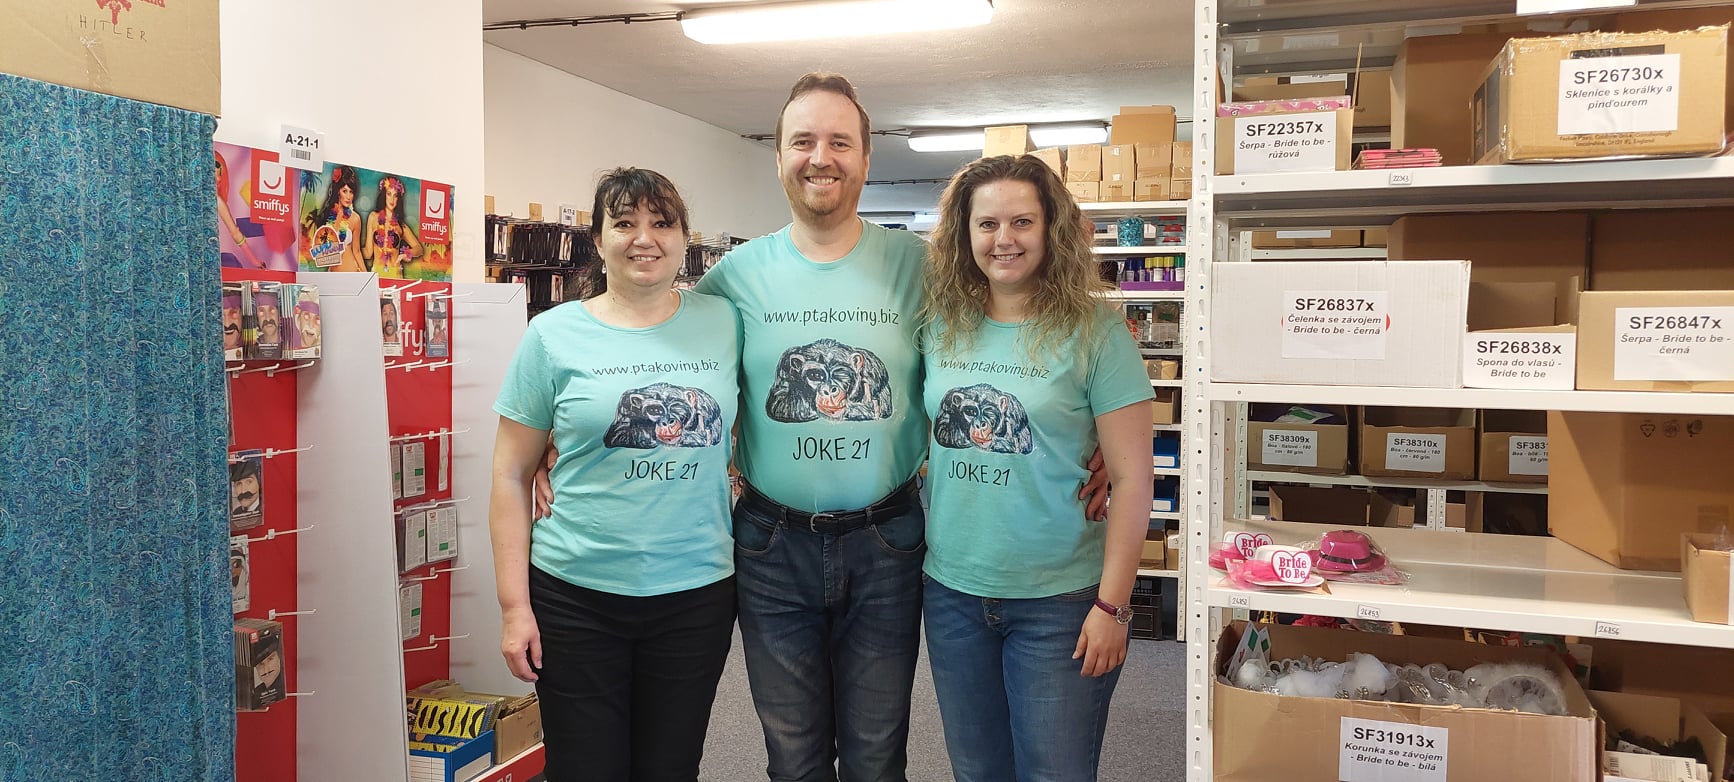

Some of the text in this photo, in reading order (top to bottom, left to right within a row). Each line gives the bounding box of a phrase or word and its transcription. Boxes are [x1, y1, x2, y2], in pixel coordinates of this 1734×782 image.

[80, 14, 147, 42] HITLER
[1574, 67, 1664, 84] SF26730x
[1565, 88, 1610, 99] Sklenice
[1622, 85, 1663, 95] korálky
[1246, 121, 1323, 136] SF22357x
[285, 133, 319, 149] A-21-1
[1239, 140, 1266, 150] Šerpa
[1274, 139, 1299, 148] Bride
[1313, 138, 1325, 146] be
[254, 198, 290, 216] smiffys
[421, 221, 447, 235] smiffys
[1295, 298, 1375, 311] SF26837x
[764, 306, 900, 326] www.ptakoviny.biz
[1287, 314, 1325, 323] Čelenka
[1341, 316, 1382, 325] závojem
[1629, 316, 1722, 329] SF26847x
[1293, 325, 1319, 333] Bride
[1321, 326, 1330, 334] to
[1333, 326, 1345, 334] be
[1353, 327, 1381, 335] černá
[1620, 333, 1652, 344] Šerpa
[1662, 334, 1692, 343] Bride
[1695, 335, 1706, 343] to
[1709, 334, 1724, 343] be
[1476, 340, 1562, 354] SF26838x
[1659, 345, 1690, 354] černá
[592, 359, 720, 376] www.ptakoviny.biz
[940, 359, 1051, 380] www.ptakoviny.biz
[1476, 358, 1508, 367] Spona
[1511, 359, 1524, 367] do
[1490, 369, 1546, 378] Bride to be
[1268, 434, 1310, 443] SF38309x
[1393, 438, 1438, 448] SF38310x
[1516, 441, 1548, 450] SF383
[792, 436, 870, 461] JOKE 21
[624, 460, 699, 481] JOKE 21
[948, 460, 1011, 487] JOKE 21
[1241, 538, 1269, 548] Bride
[1278, 556, 1307, 568] Bride
[1294, 568, 1306, 578] Be
[1353, 727, 1435, 748] SF31913x
[1344, 742, 1385, 754] Korunka
[1402, 750, 1443, 761] závojem
[1356, 754, 1382, 764] Bride
[1418, 763, 1437, 771] bílá
